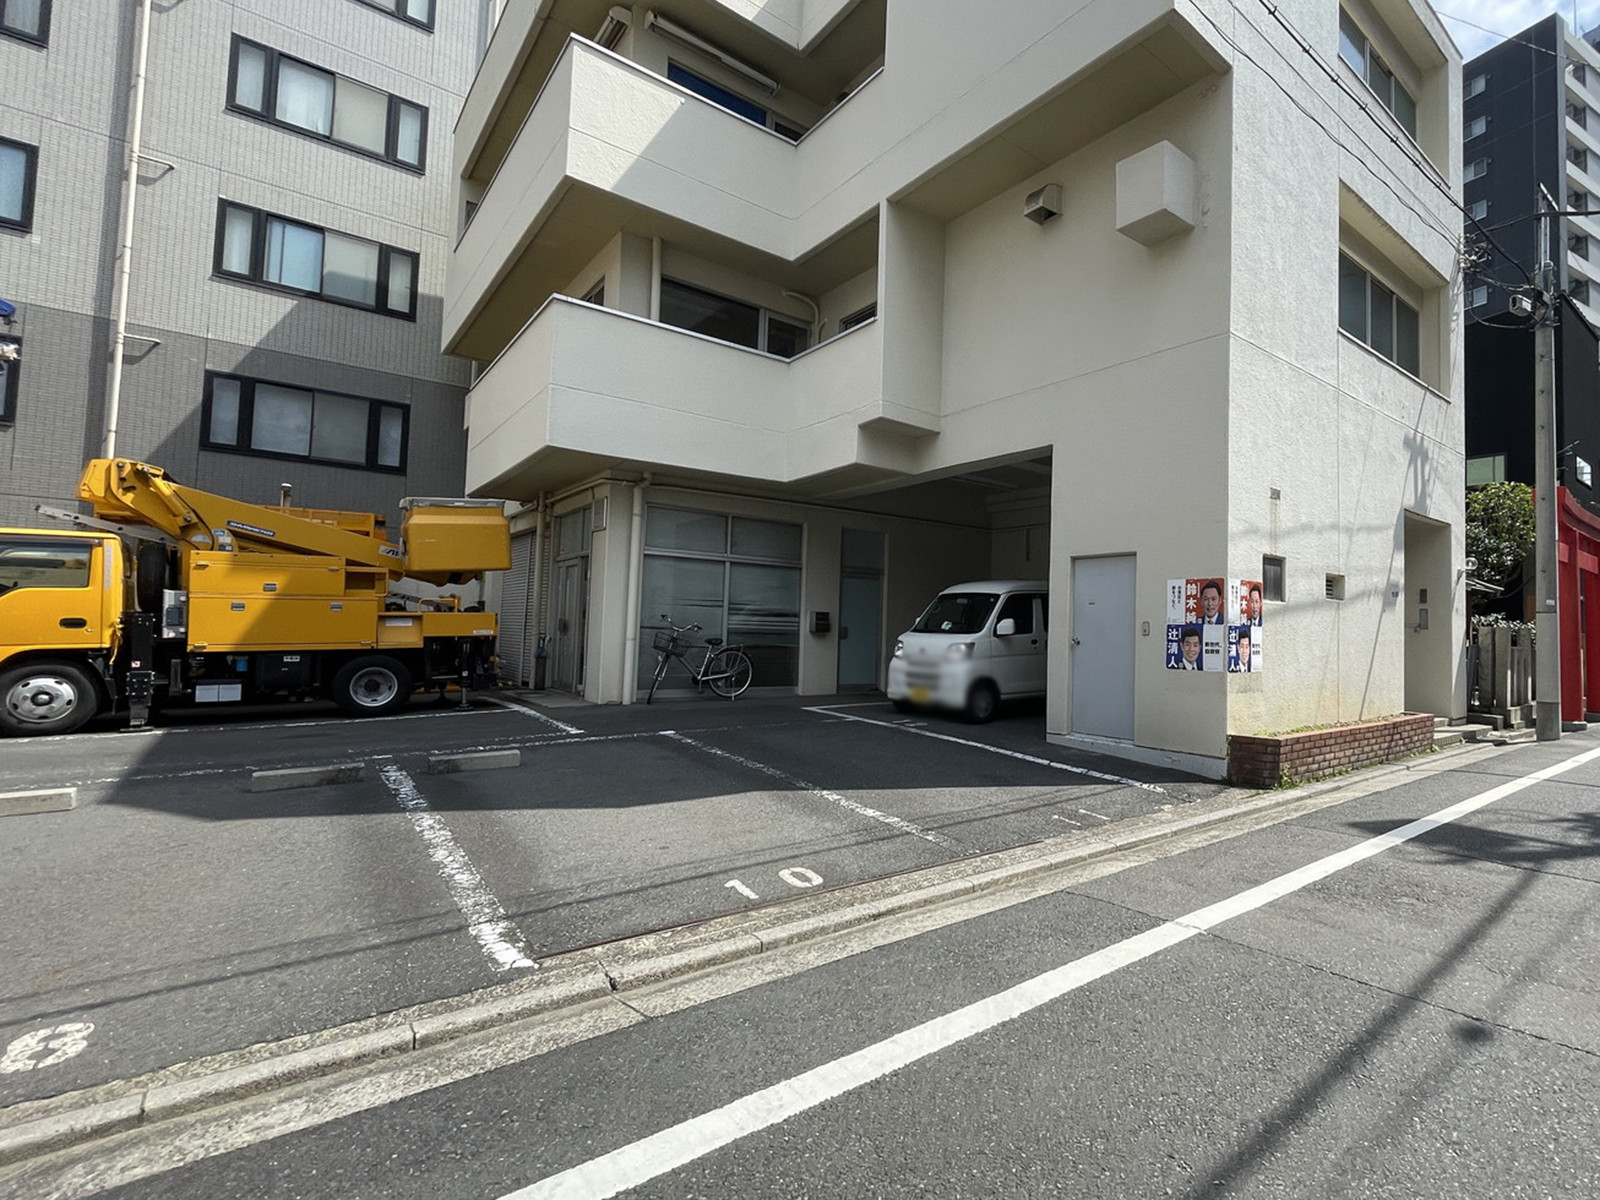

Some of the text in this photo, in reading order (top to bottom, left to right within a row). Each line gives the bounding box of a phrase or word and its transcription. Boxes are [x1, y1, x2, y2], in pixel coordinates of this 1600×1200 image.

[1168, 628, 1178, 668] 辻清人
[724, 867, 824, 899] 10
